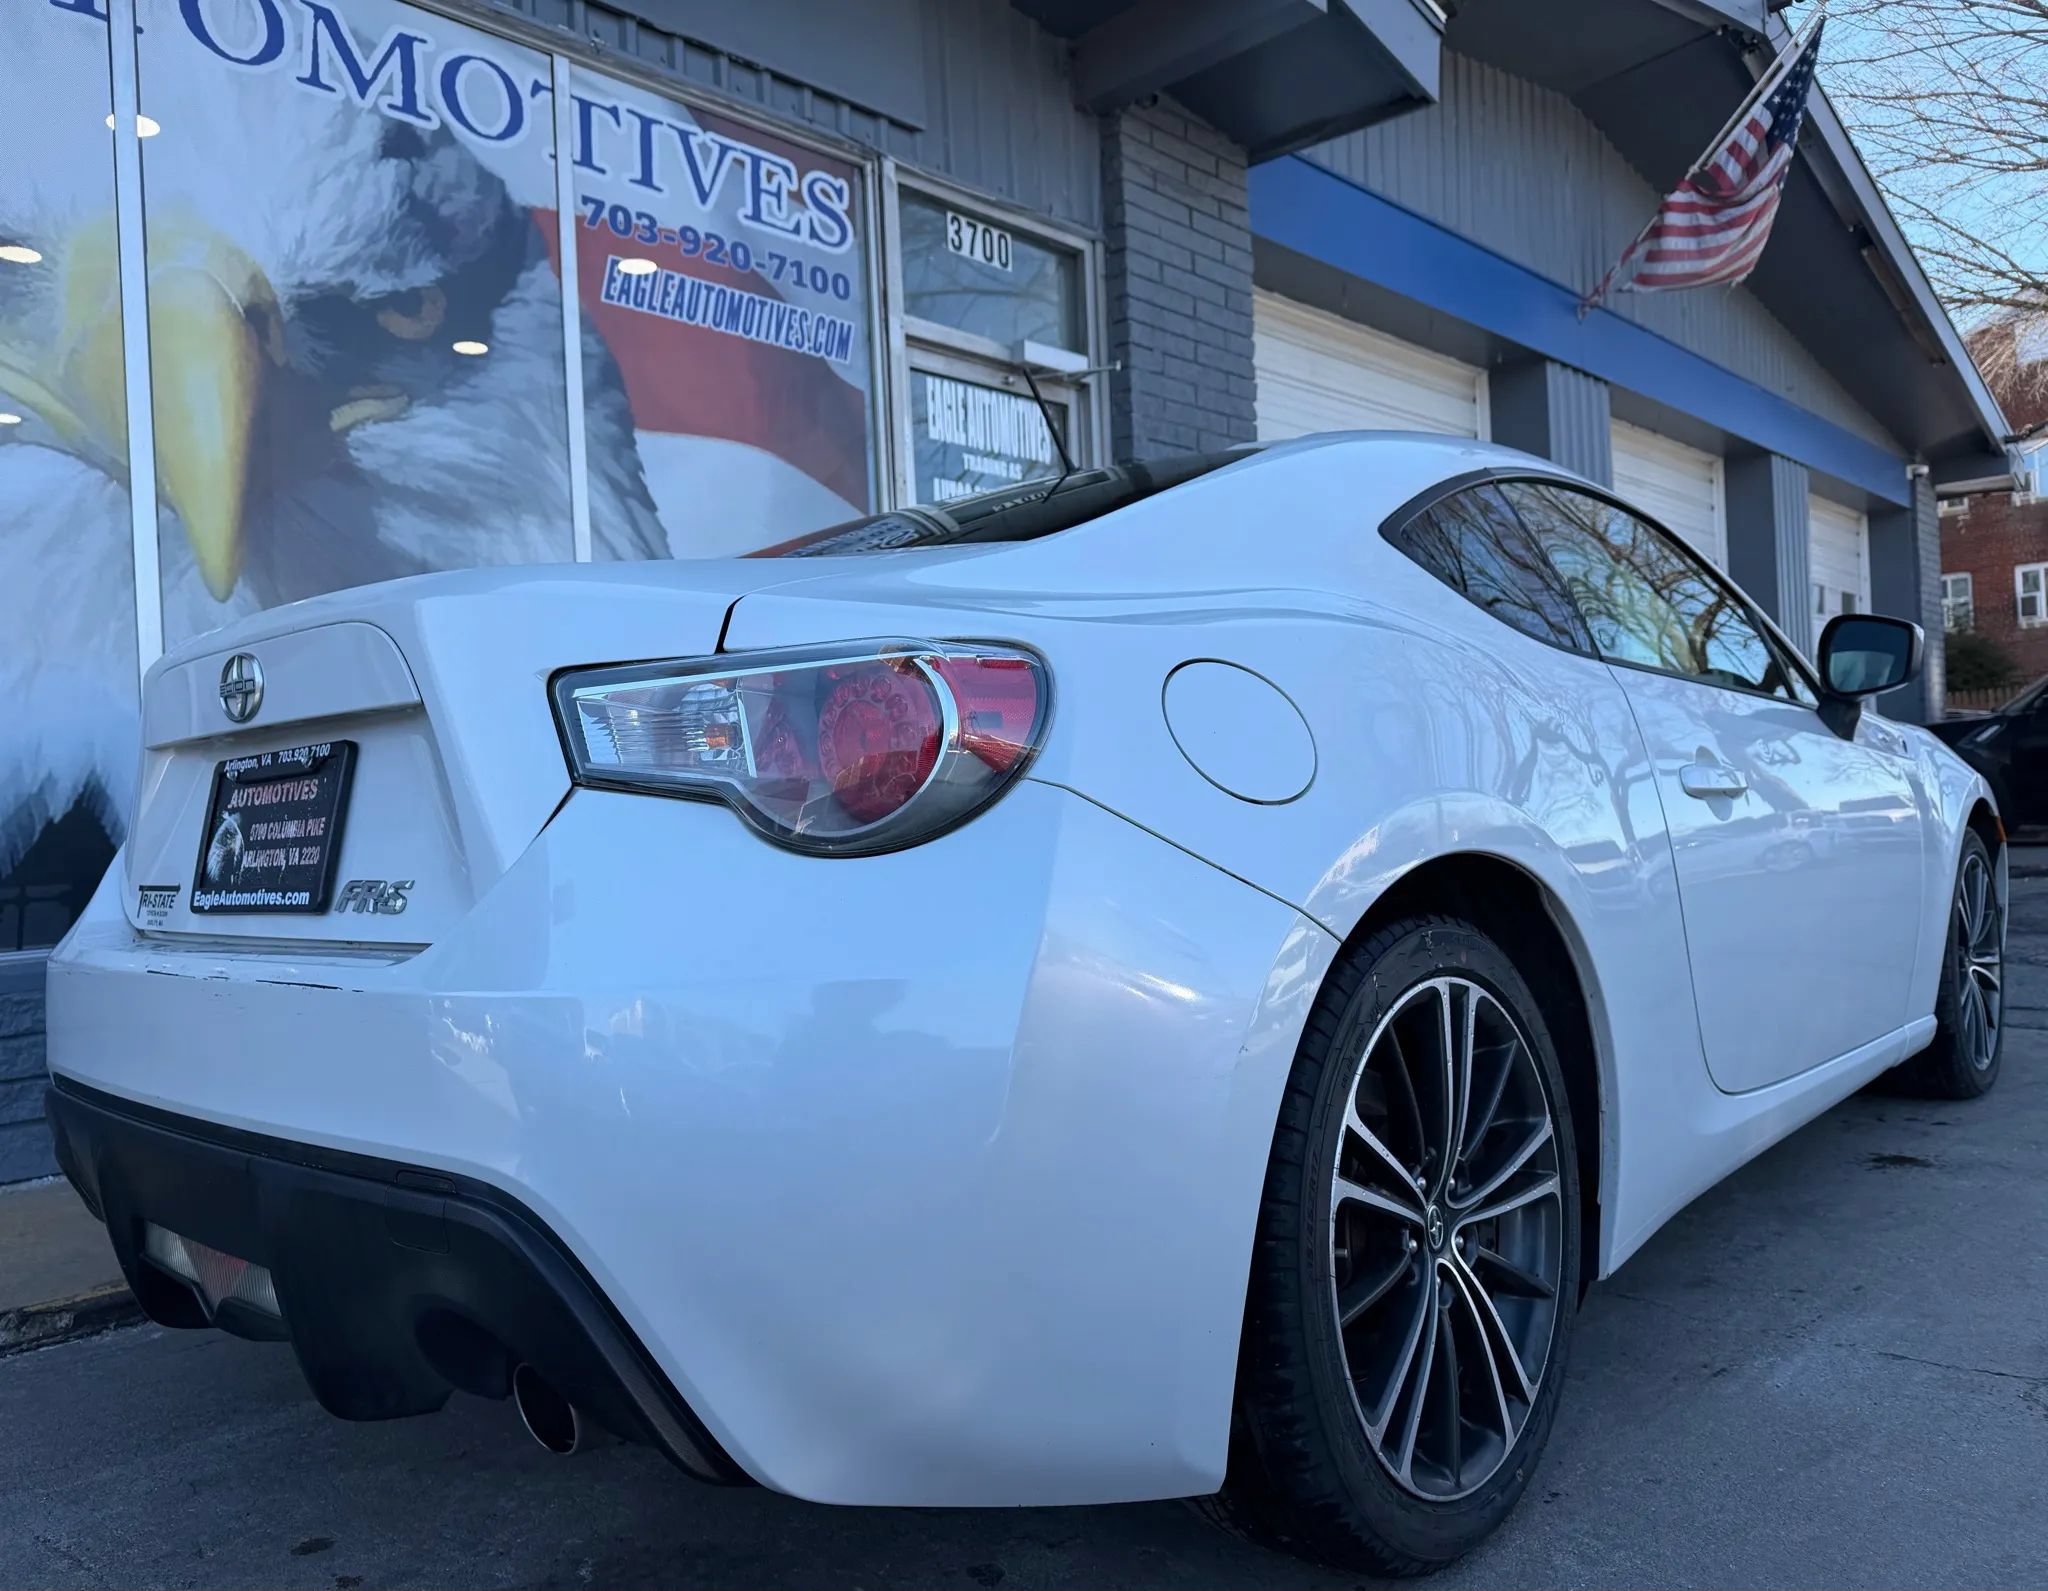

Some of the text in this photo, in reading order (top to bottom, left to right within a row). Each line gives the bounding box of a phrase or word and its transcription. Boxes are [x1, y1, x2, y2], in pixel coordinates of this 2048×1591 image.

[50, 0, 849, 248] OMOTIVES
[579, 196, 850, 301] 703-920-7100
[950, 214, 1009, 269] 3700
[604, 257, 852, 361] EAGLEAUTOMOTIVES.COM
[926, 376, 1052, 465] EAGLE AUTOMOTIVES
[224, 743, 331, 774] Arlington, VA 703.9207100
[227, 778, 319, 809] AUTOMOTIVES
[267, 818, 305, 840] COLUMBIA
[305, 816, 326, 837] PIKE
[288, 847, 300, 866] VA
[137, 883, 181, 918] TRI-STATE
[193, 889, 310, 910] EagleAutomotives.com
